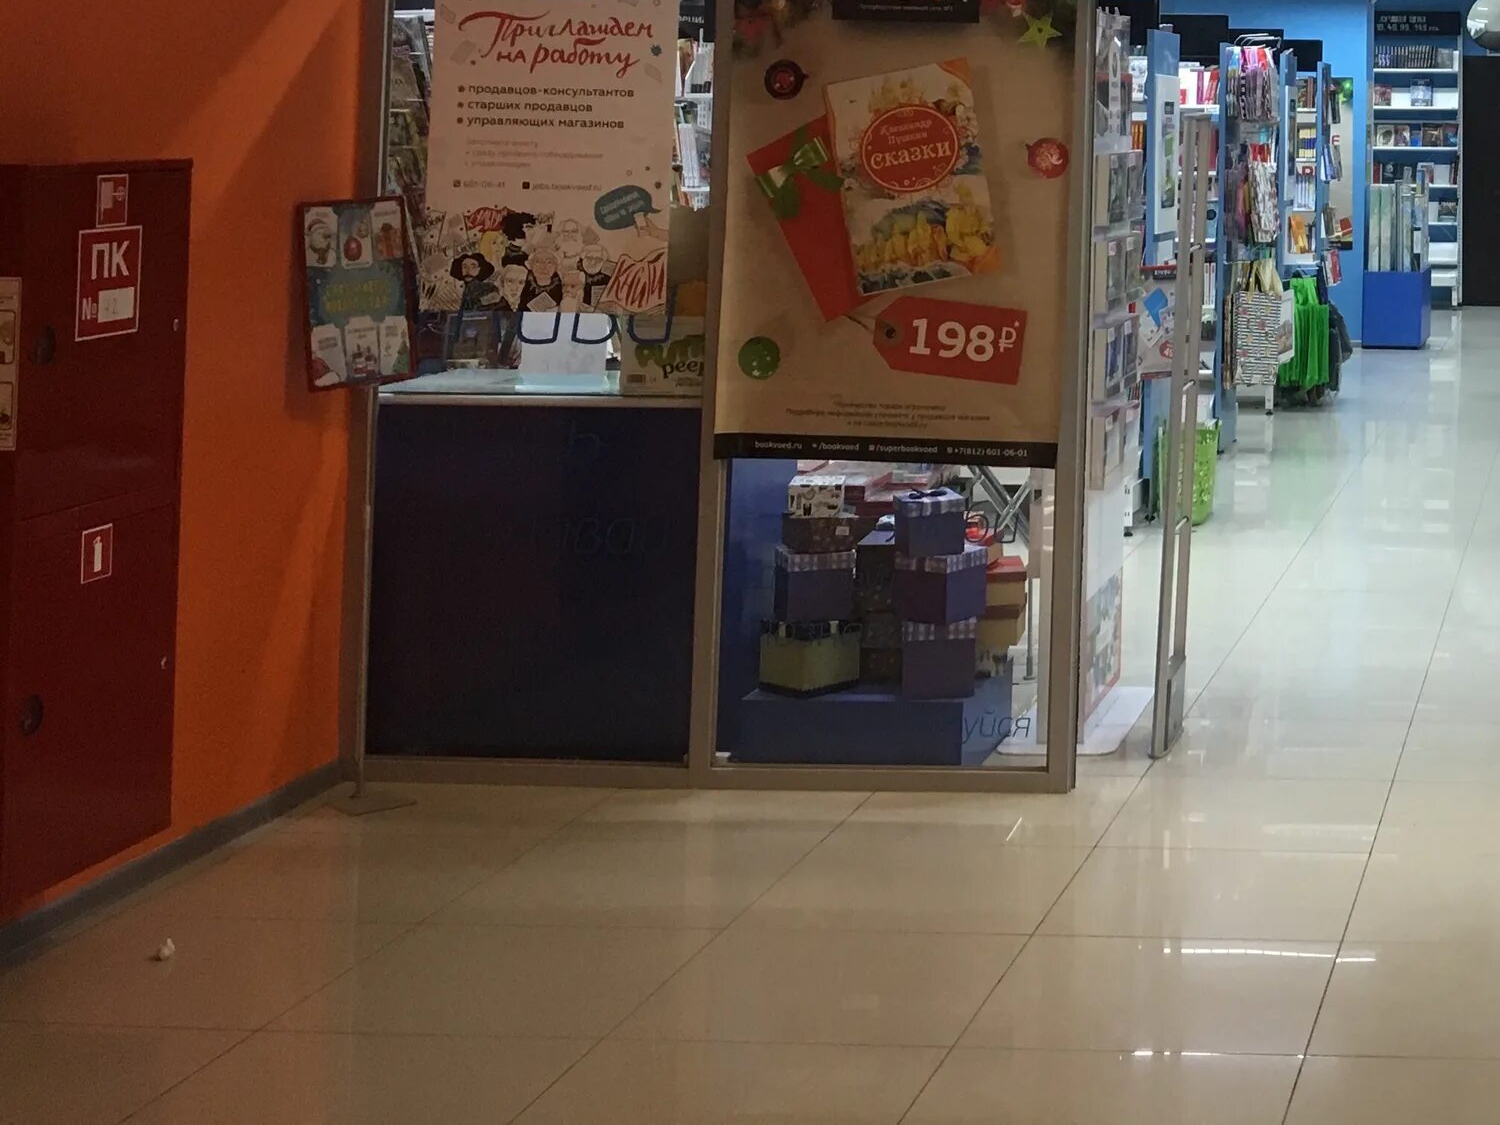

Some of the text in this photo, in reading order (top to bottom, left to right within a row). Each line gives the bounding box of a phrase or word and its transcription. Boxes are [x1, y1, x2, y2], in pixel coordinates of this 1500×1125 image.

[530, 37, 641, 79] работу
[468, 84, 635, 98] продавцов-консультантов
[467, 100, 593, 113] старших продавцов
[467, 116, 625, 130] управляющих магазинов
[91, 240, 131, 280] ПК
